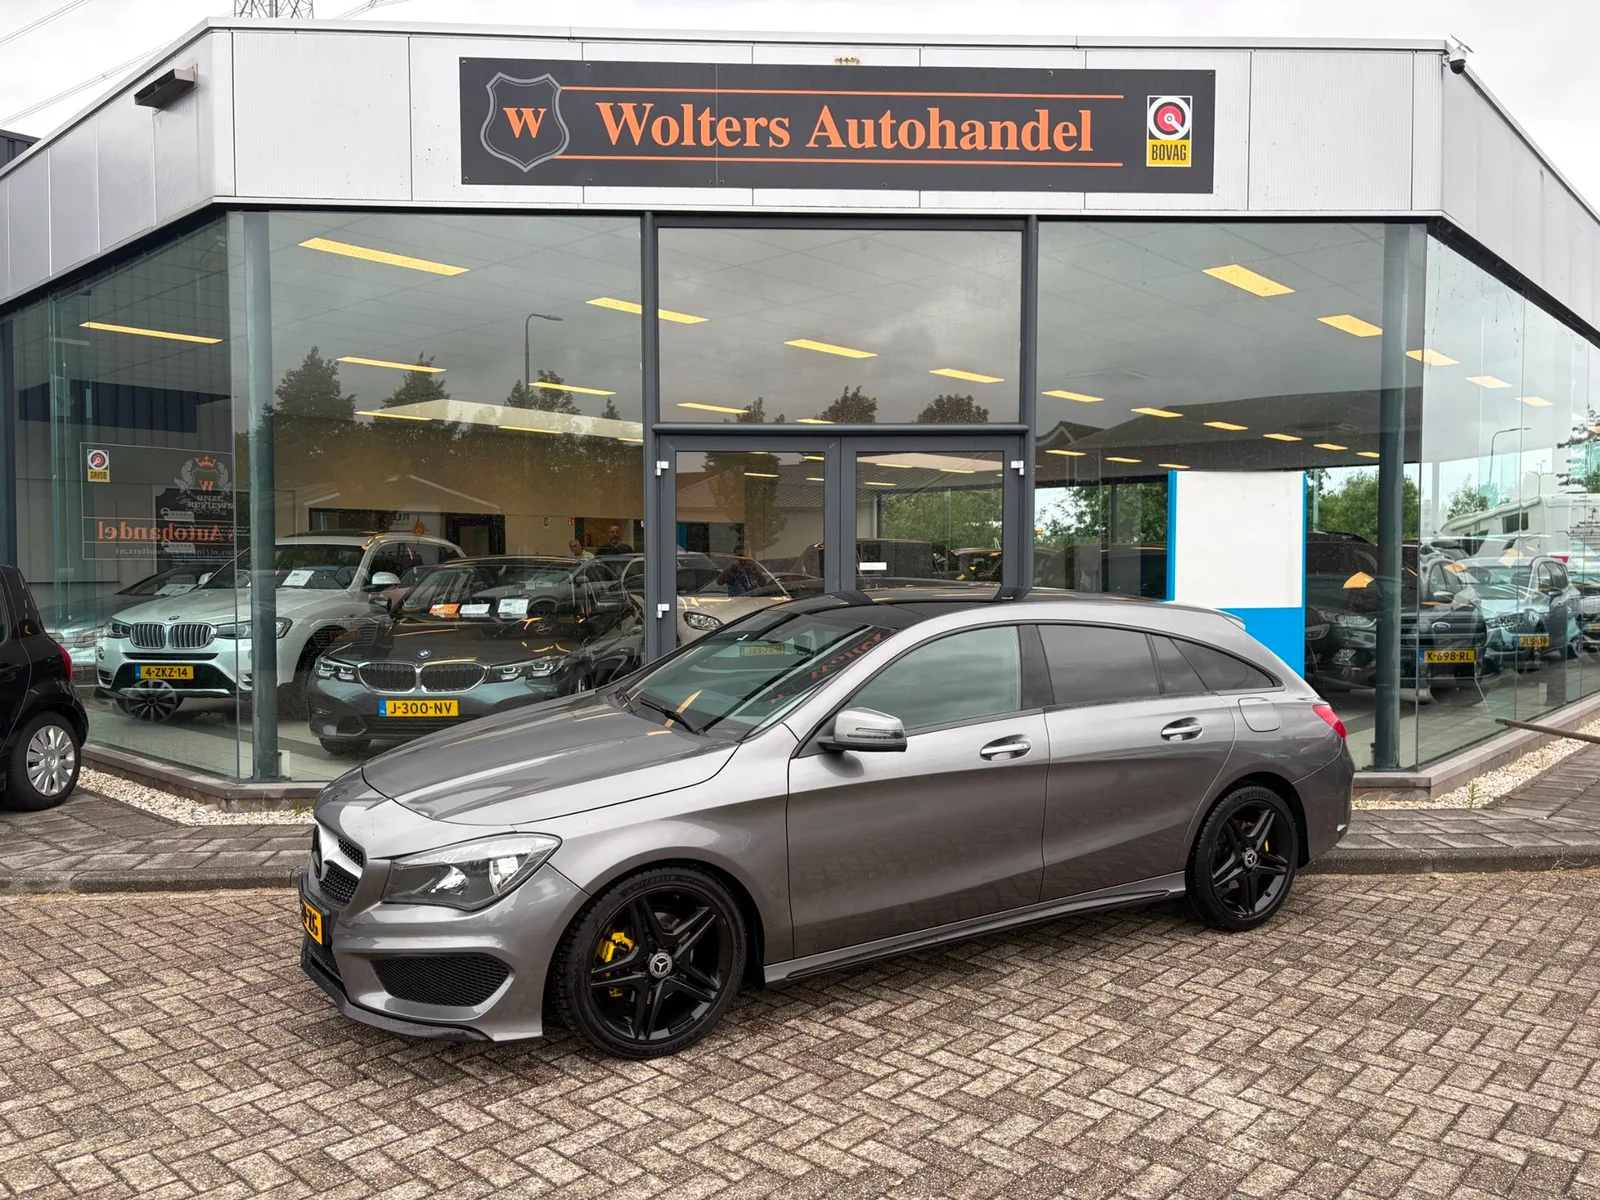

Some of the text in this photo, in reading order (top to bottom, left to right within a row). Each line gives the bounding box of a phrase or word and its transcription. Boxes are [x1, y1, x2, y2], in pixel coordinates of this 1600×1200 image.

[503, 107, 547, 139] W
[596, 102, 1093, 154] Wolters Autohandel
[1151, 144, 1187, 161] BOVAG
[187, 501, 234, 510] REVIEWS
[1426, 651, 1472, 661] K-698-RL
[145, 667, 188, 677] 4-ZKZ-14
[390, 702, 452, 714] J-300-NV
